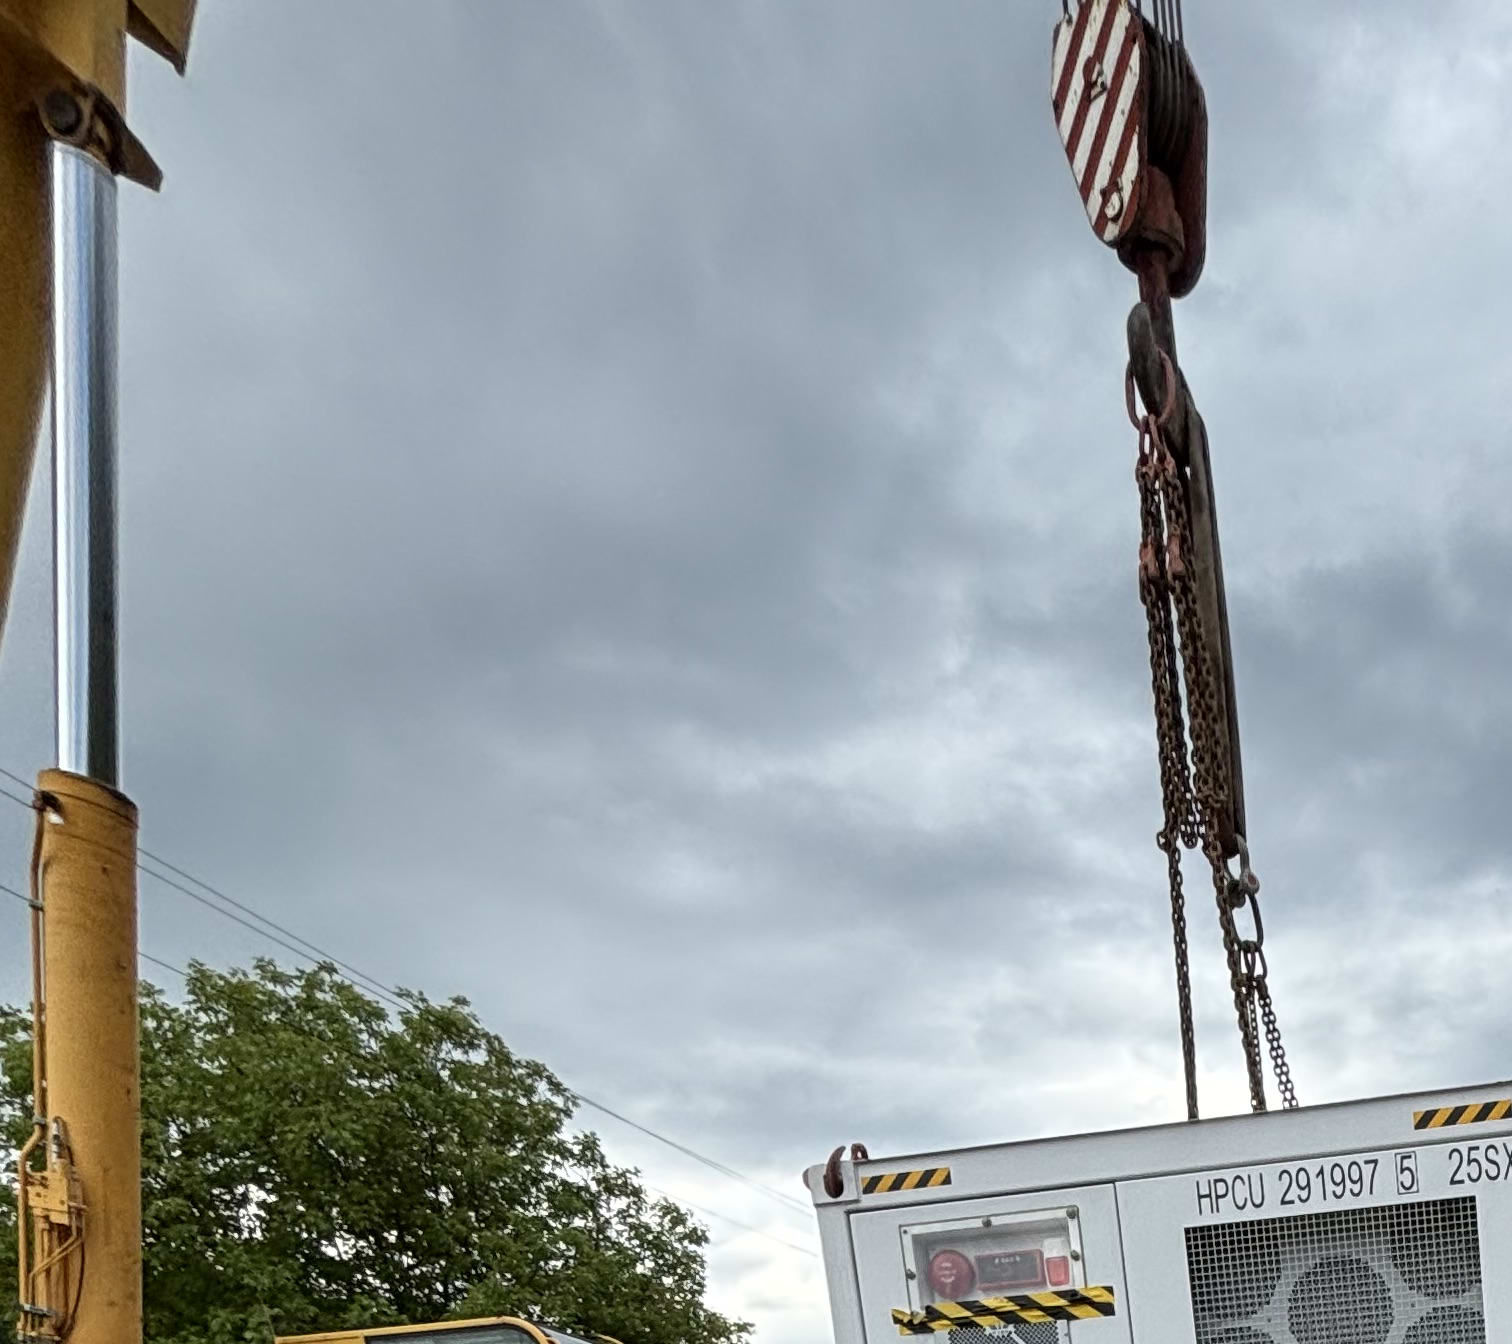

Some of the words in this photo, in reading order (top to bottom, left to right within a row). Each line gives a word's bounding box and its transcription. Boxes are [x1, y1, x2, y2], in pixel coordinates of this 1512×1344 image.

[1196, 1172, 1265, 1216] HPCU
[1278, 1158, 1379, 1206] 291997
[1398, 1153, 1417, 1193] 5
